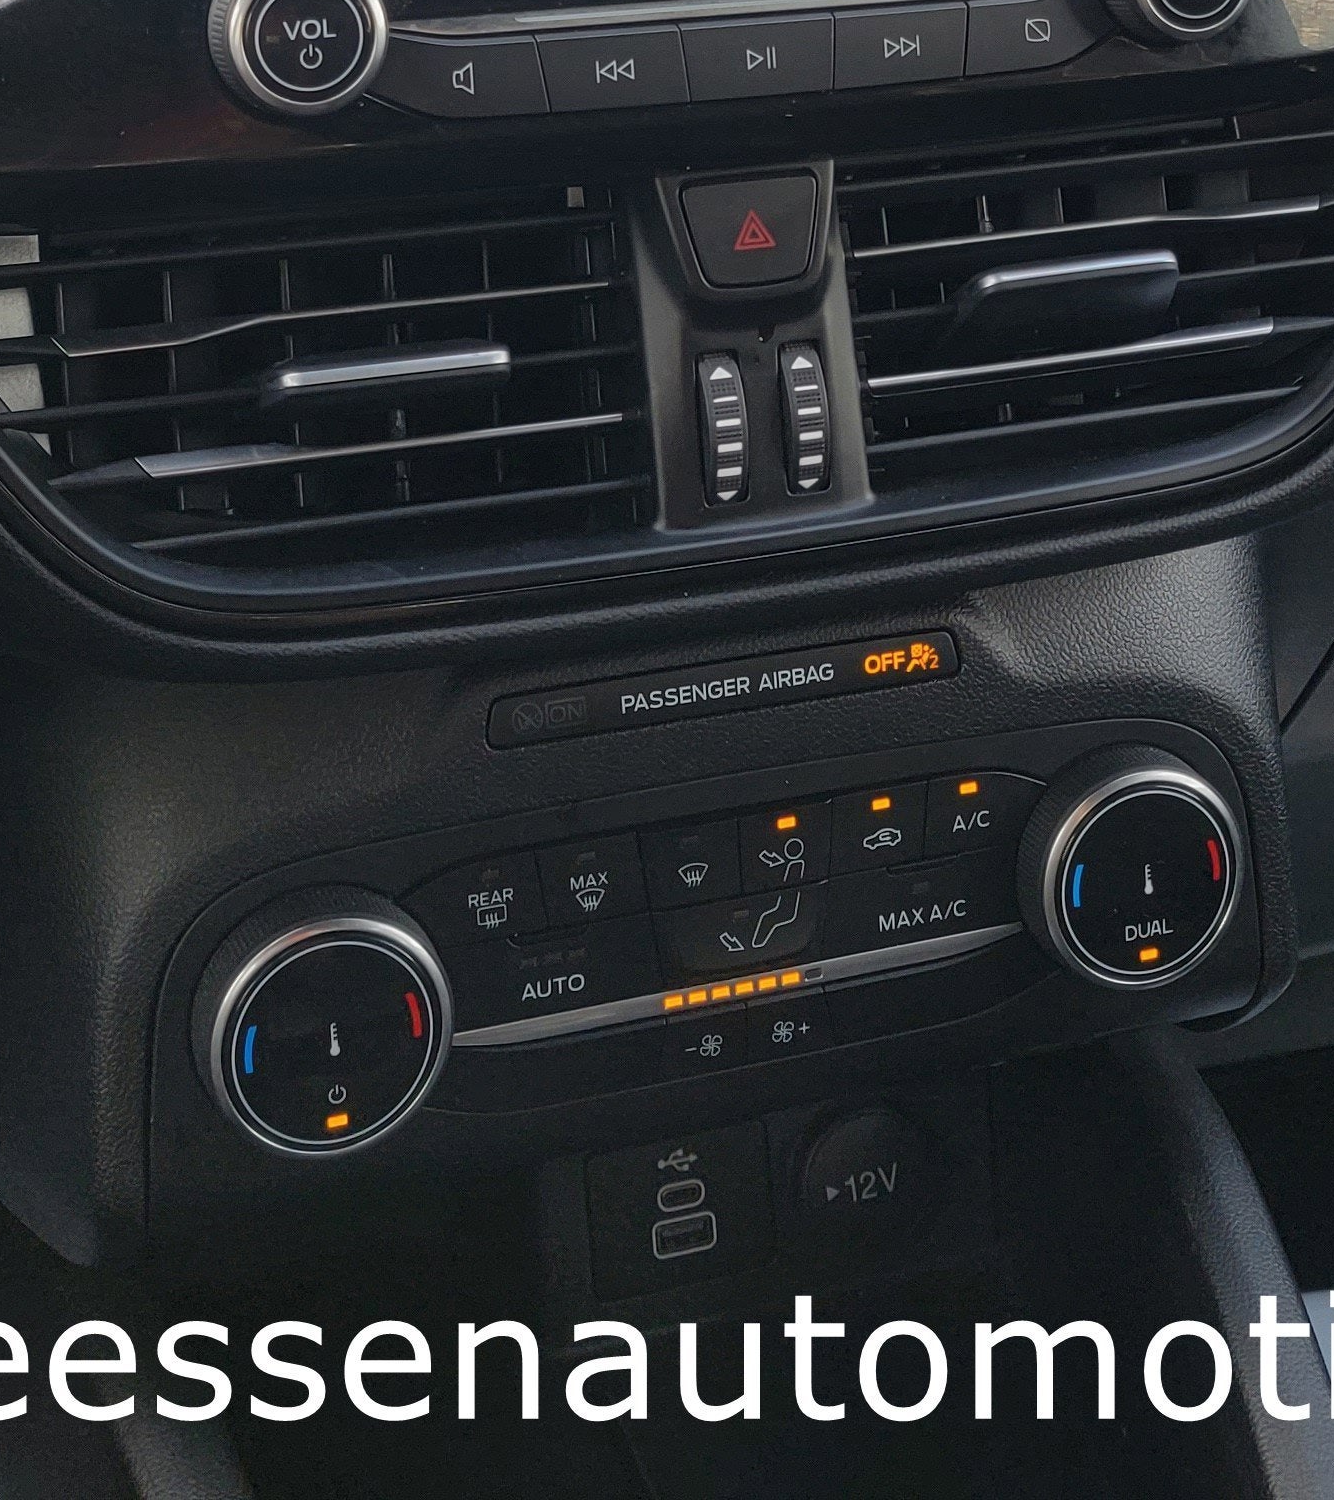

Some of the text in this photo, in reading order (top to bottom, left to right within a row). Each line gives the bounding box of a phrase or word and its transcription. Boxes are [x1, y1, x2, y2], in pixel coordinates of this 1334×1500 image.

[282, 18, 337, 42] VOL
[864, 650, 907, 675] OFF
[620, 663, 835, 715] PASSENGER AIRBAG
[952, 810, 991, 833] A/C
[570, 871, 609, 891] MAX
[467, 888, 515, 909] REAR
[878, 900, 968, 932] MAX A/C
[1124, 919, 1175, 942] DUAL
[521, 973, 586, 1002] AUTO
[844, 1161, 897, 1202] 12V
